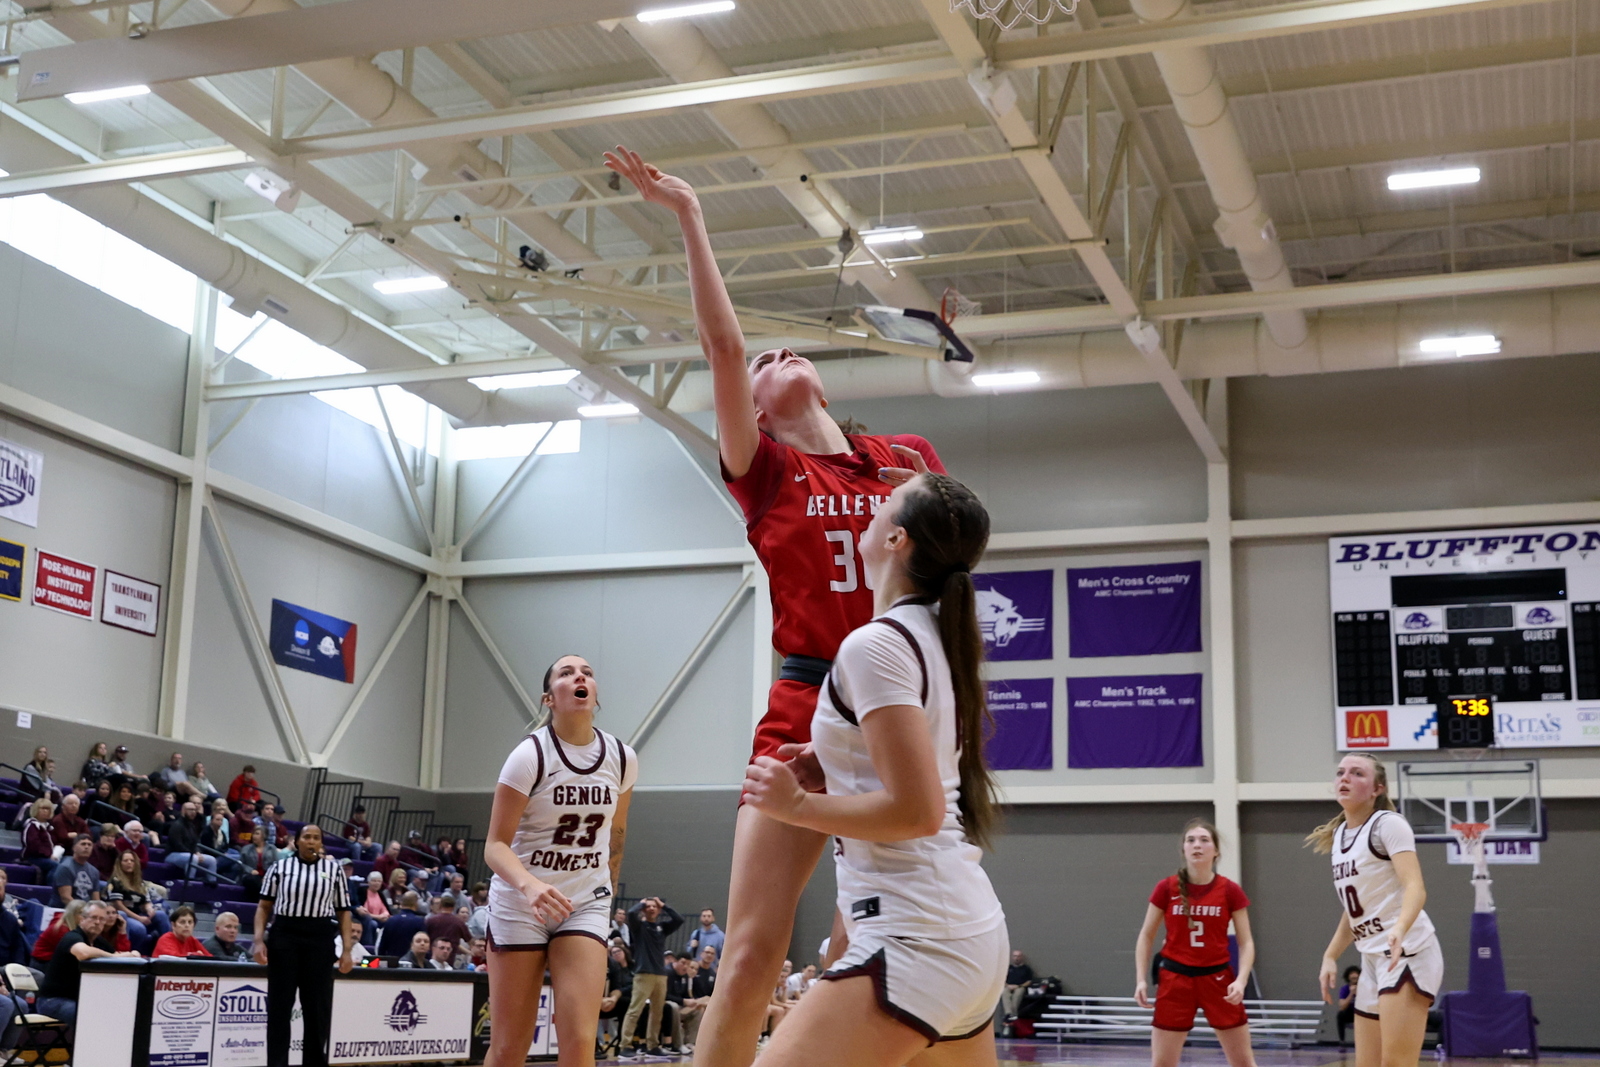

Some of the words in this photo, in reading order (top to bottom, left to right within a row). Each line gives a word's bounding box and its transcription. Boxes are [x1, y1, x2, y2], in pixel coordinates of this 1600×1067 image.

[806, 494, 892, 516] BELLEV
[42, 558, 91, 582] ROSE-HULMAN
[825, 530, 874, 592] 3
[1353, 551, 1589, 571] UNIVERSITY
[47, 575, 84, 594] INSTITUTE
[1078, 577, 1109, 588] Men's
[1112, 576, 1144, 586] Cross
[1146, 574, 1190, 585] Country
[35, 587, 47, 598] OF
[48, 589, 92, 611] TECHNOLOGY
[112, 583, 153, 602] TRANSYLVANIA
[115, 605, 147, 622] UNIVERSITY
[1398, 633, 1449, 646] BLUFFTON
[1523, 629, 1557, 641] GUEST
[1458, 667, 1485, 675] PLAYER
[988, 690, 1022, 700] Tennis
[1101, 687, 1134, 697] Men's
[1136, 686, 1167, 696] Track
[1452, 699, 1489, 716] 7:36
[553, 785, 612, 805] GENOA
[552, 813, 605, 847] 23
[1495, 841, 1531, 854] DAM
[530, 850, 602, 872] COMETS
[1172, 904, 1221, 916] BELEVUE
[1190, 921, 1204, 947] 2
[1354, 918, 1384, 941] METS
[155, 979, 214, 994] Interdyne
[333, 1039, 467, 1058] BLUFFTONBEAVERS.COM
